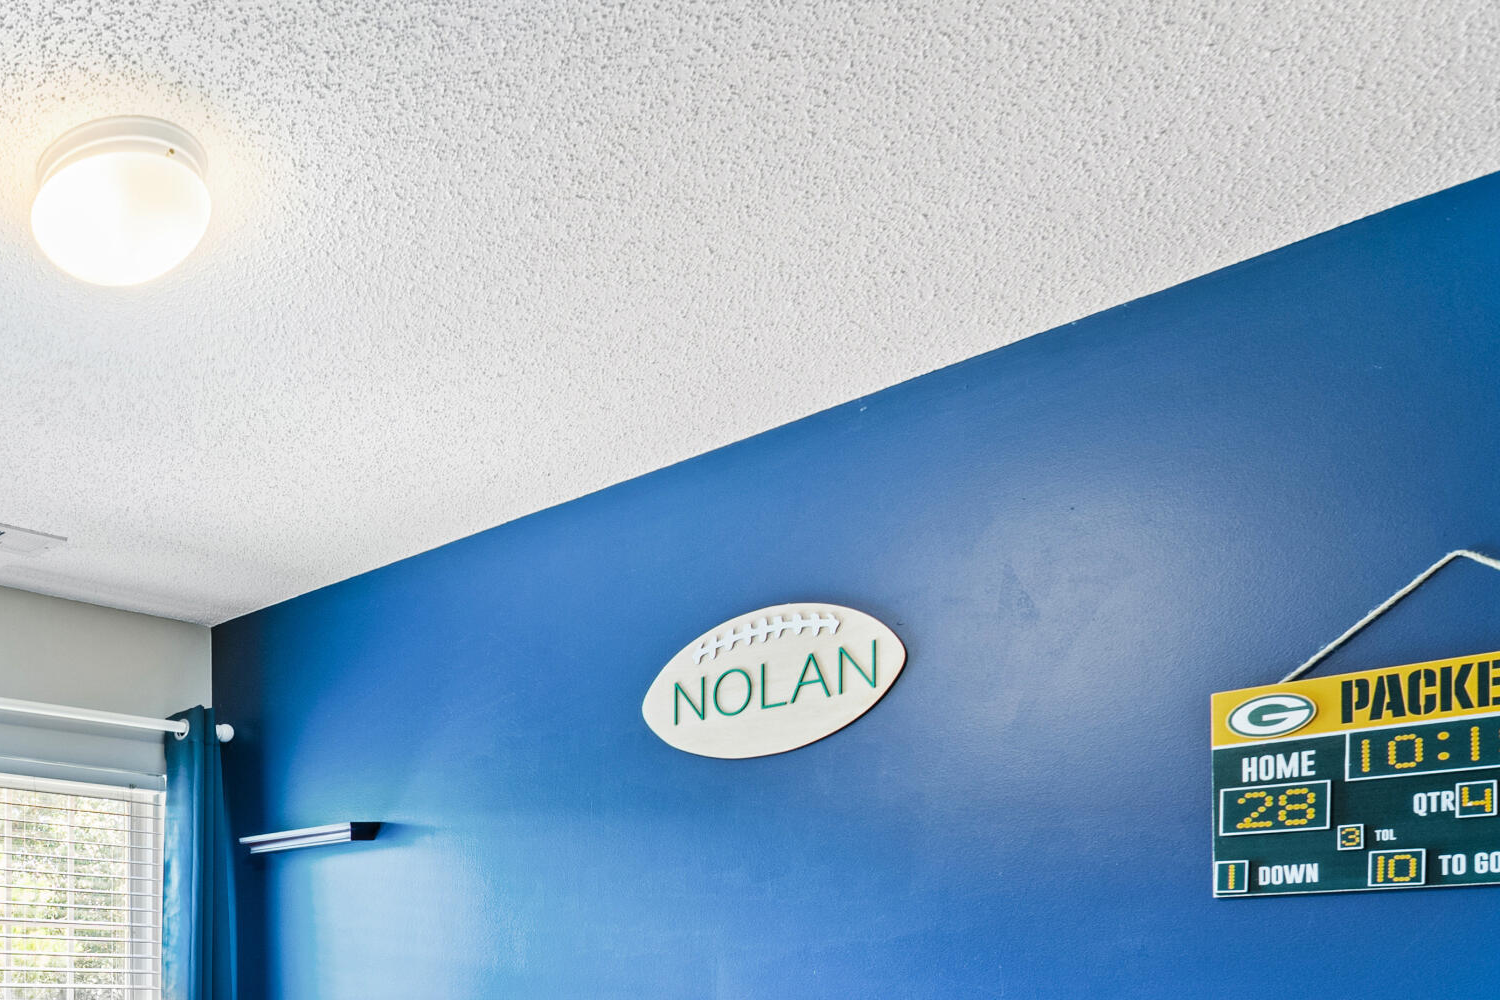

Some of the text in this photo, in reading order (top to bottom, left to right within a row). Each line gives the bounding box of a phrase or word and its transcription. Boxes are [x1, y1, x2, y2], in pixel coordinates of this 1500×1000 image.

[673, 639, 877, 727] NOLAN
[1242, 750, 1316, 783] HOME
[1236, 787, 1316, 829] 28
[1412, 786, 1493, 816] QTR 4
[1341, 827, 1397, 846] 3 TOL
[1228, 864, 1236, 890] 1
[1258, 863, 1319, 886] DOWN
[1376, 854, 1417, 883] 10
[1438, 854, 1467, 876] TO
